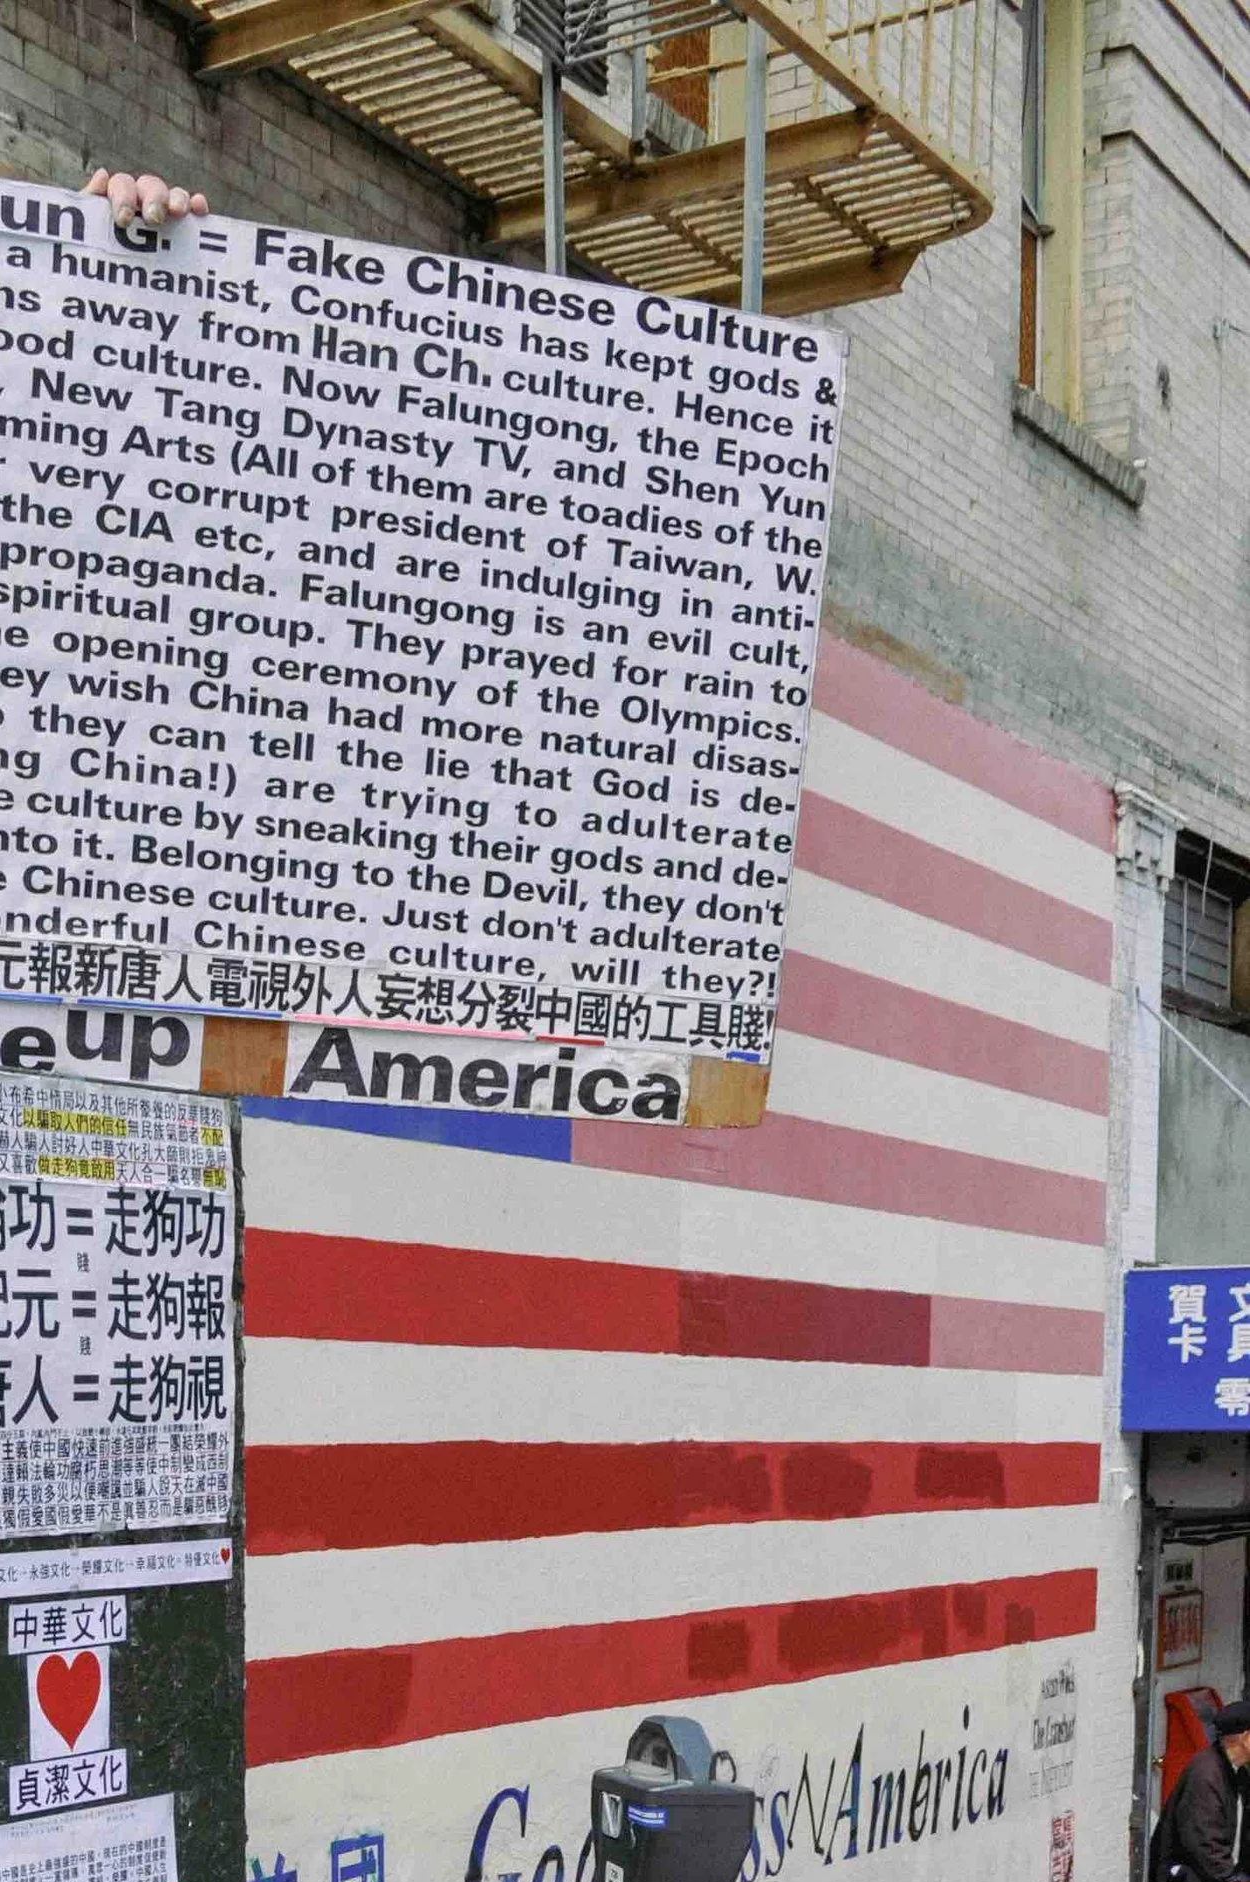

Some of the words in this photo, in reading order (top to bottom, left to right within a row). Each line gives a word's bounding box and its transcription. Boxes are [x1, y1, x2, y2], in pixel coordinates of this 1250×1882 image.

[5, 244, 31, 269] a
[51, 241, 271, 313] humanist,
[290, 283, 503, 347] Confucius
[519, 322, 589, 362] has
[604, 337, 693, 382] kept
[707, 364, 800, 399] gods
[814, 376, 838, 407] &
[253, 228, 385, 286] Fake
[405, 255, 616, 327] Chinese
[635, 296, 820, 365] Culture
[60, 295, 179, 342] away
[197, 309, 300, 355] from
[311, 322, 398, 372] Han
[412, 341, 492, 388] Ch.
[502, 368, 654, 414] culture.
[674, 389, 793, 437] Hence
[809, 413, 834, 445] it
[30, 366, 133, 411] New
[153, 385, 261, 439] Tang
[282, 405, 454, 468] Dynasty
[472, 435, 531, 478] TV,
[552, 458, 626, 489] and
[644, 464, 740, 507] Shen
[759, 482, 826, 522] Yun
[28, 460, 125, 501] very
[147, 477, 310, 524] corrupt
[330, 504, 526, 553] president
[546, 532, 588, 561] of
[606, 537, 753, 591] Taiwan,
[775, 562, 816, 596] W.
[0, 541, 277, 597] propaganda.
[299, 572, 515, 636] Falungong
[533, 604, 564, 636] is
[581, 620, 629, 645] an
[647, 627, 712, 656] evil
[728, 638, 809, 675] cult,
[67, 669, 169, 705] wish
[188, 679, 309, 721] China
[327, 695, 404, 733] had
[420, 715, 523, 747] more
[539, 730, 676, 765] natural
[691, 742, 800, 779] disas-
[69, 746, 237, 798] China!)
[263, 776, 335, 803] are
[360, 782, 489, 827] trying
[514, 799, 557, 828] to
[580, 808, 792, 854] adulterate
[193, 919, 365, 961] Chinese
[388, 941, 546, 982] culture,
[570, 956, 640, 986] will
[660, 963, 776, 1000] they?!
[289, 1026, 683, 1121] America
[12, 1599, 124, 1650] 中華文化
